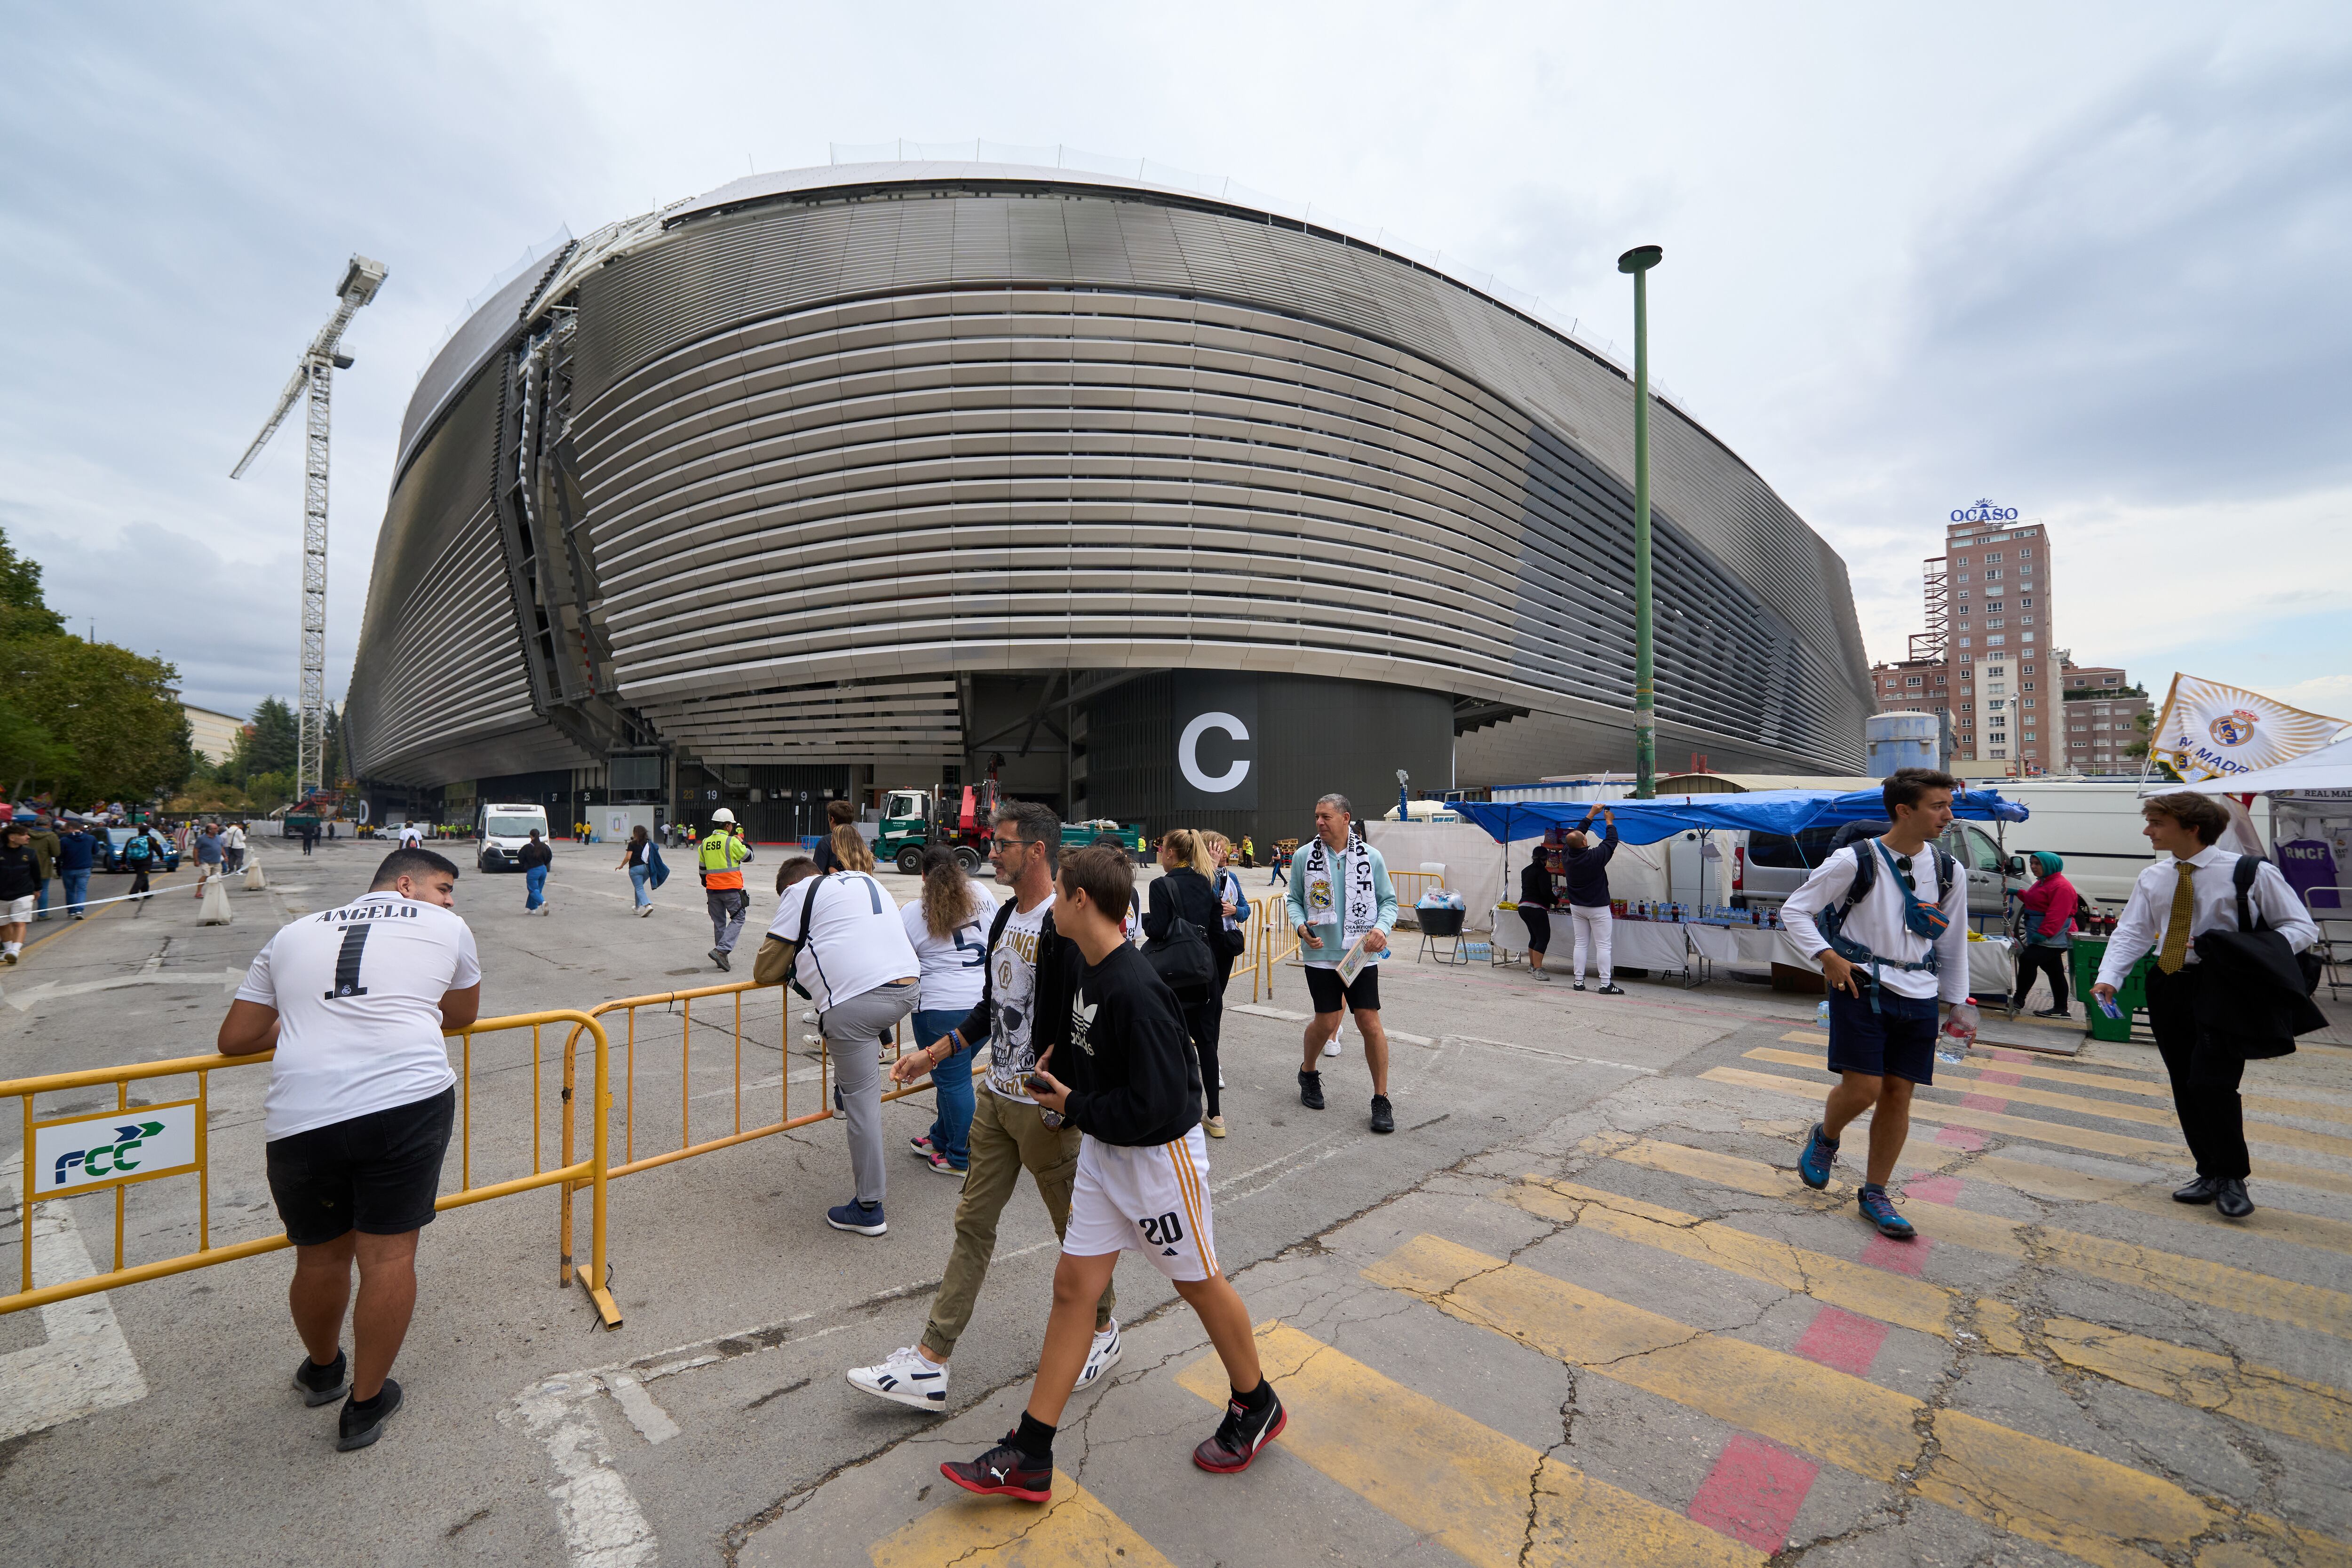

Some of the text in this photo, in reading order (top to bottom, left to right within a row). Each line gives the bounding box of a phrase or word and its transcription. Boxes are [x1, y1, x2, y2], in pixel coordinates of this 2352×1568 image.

[1950, 508, 2018, 522] OCASO
[1178, 712, 1250, 792] C
[584, 792, 590, 801] 25
[683, 790, 694, 799] 23
[707, 790, 717, 800] 19
[801, 791, 807, 801] 9
[359, 800, 369, 824] D
[706, 841, 721, 851] ESB
[2285, 848, 2326, 860] RMCF
[837, 876, 882, 915] 7
[315, 905, 418, 922] ANGELO
[952, 920, 986, 967] 5
[325, 923, 372, 1000] 1
[56, 1140, 142, 1184] FCC
[1139, 1211, 1183, 1245] 20
[1091, 1350, 1101, 1362] Reebok
